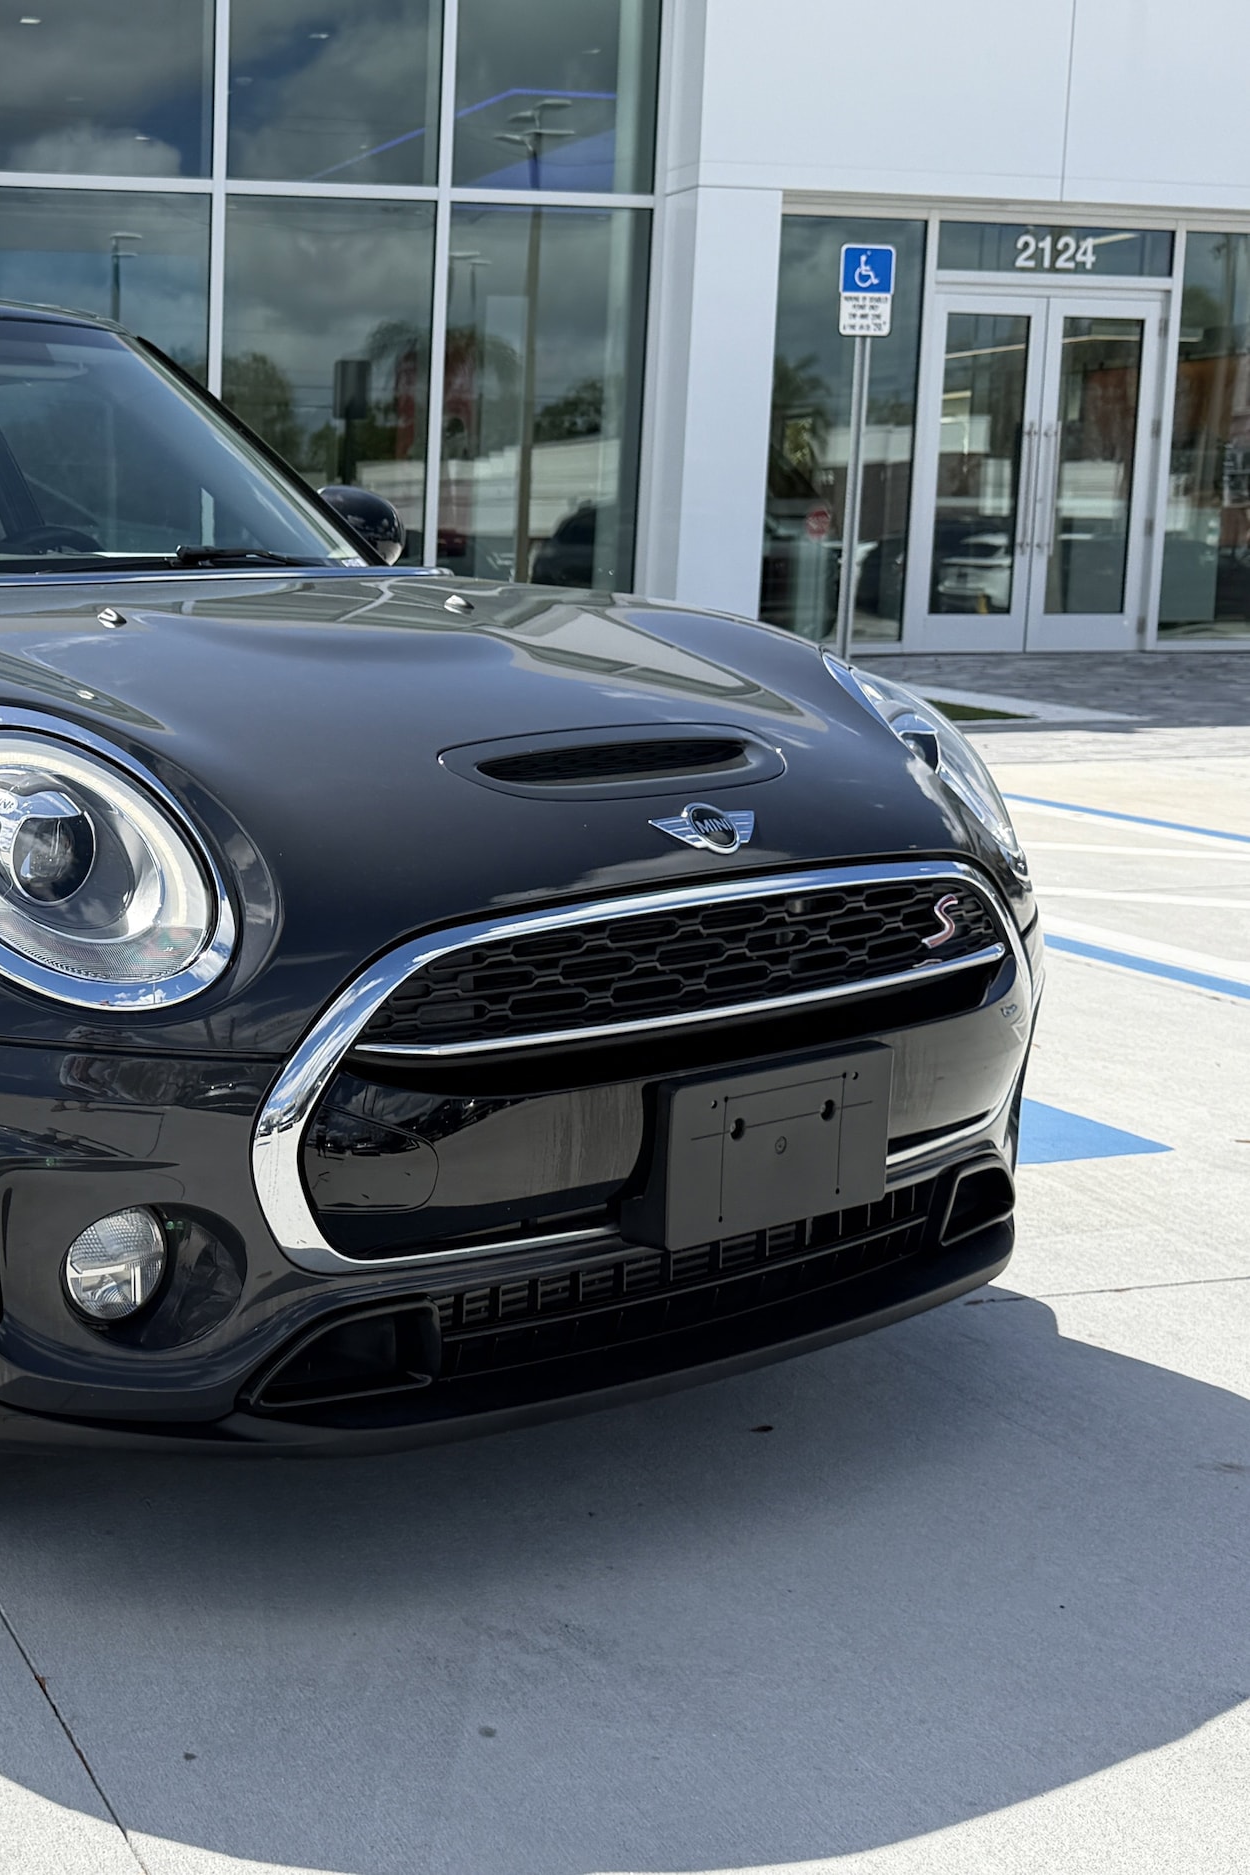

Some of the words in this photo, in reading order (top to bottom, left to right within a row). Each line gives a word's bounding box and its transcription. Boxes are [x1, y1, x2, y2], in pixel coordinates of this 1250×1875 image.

[1014, 234, 1096, 269] 2124
[695, 818, 733, 834] MINI
[921, 894, 958, 949] S
